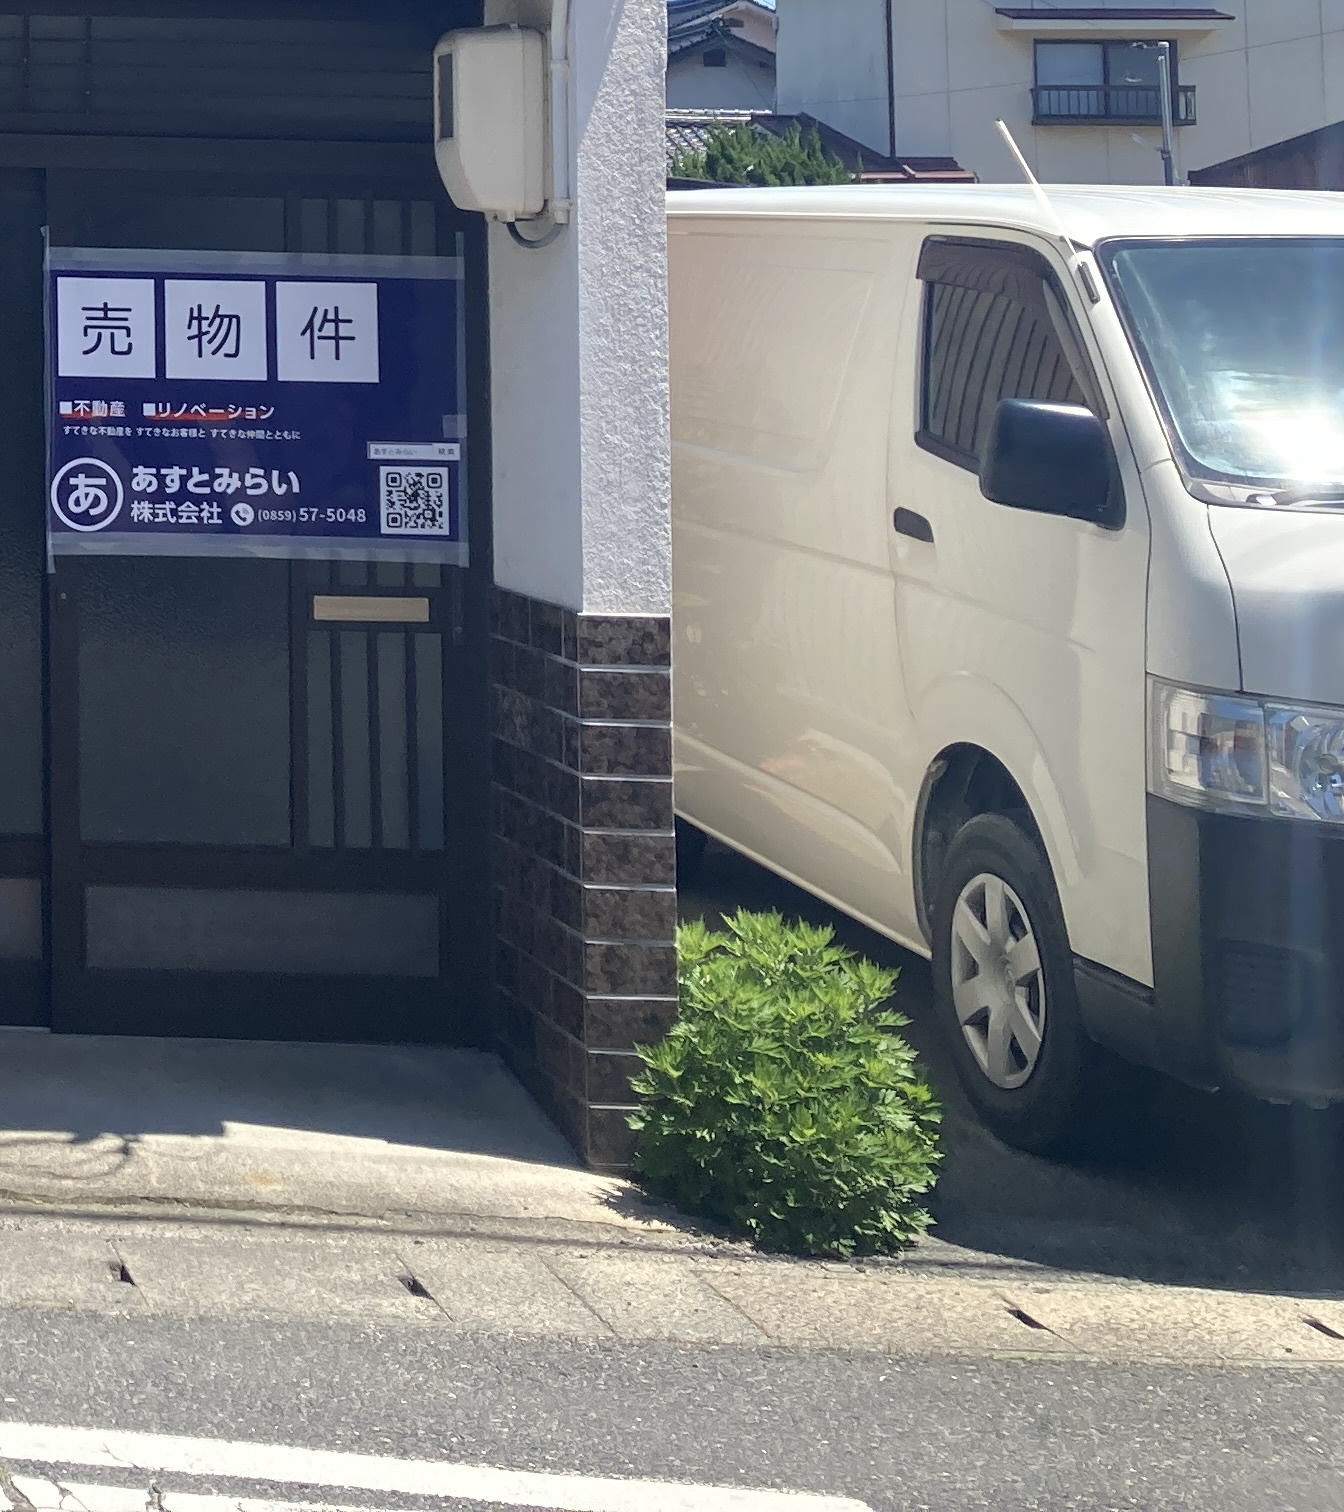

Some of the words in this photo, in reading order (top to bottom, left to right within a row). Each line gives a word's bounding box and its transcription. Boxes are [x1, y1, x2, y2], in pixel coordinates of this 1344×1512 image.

[81, 301, 357, 361] 売物件
[73, 400, 127, 417] 不動産
[157, 402, 276, 420] リノベーション
[67, 473, 109, 517] あ
[130, 465, 301, 496] あすとみらい
[129, 500, 224, 525] 株式会社
